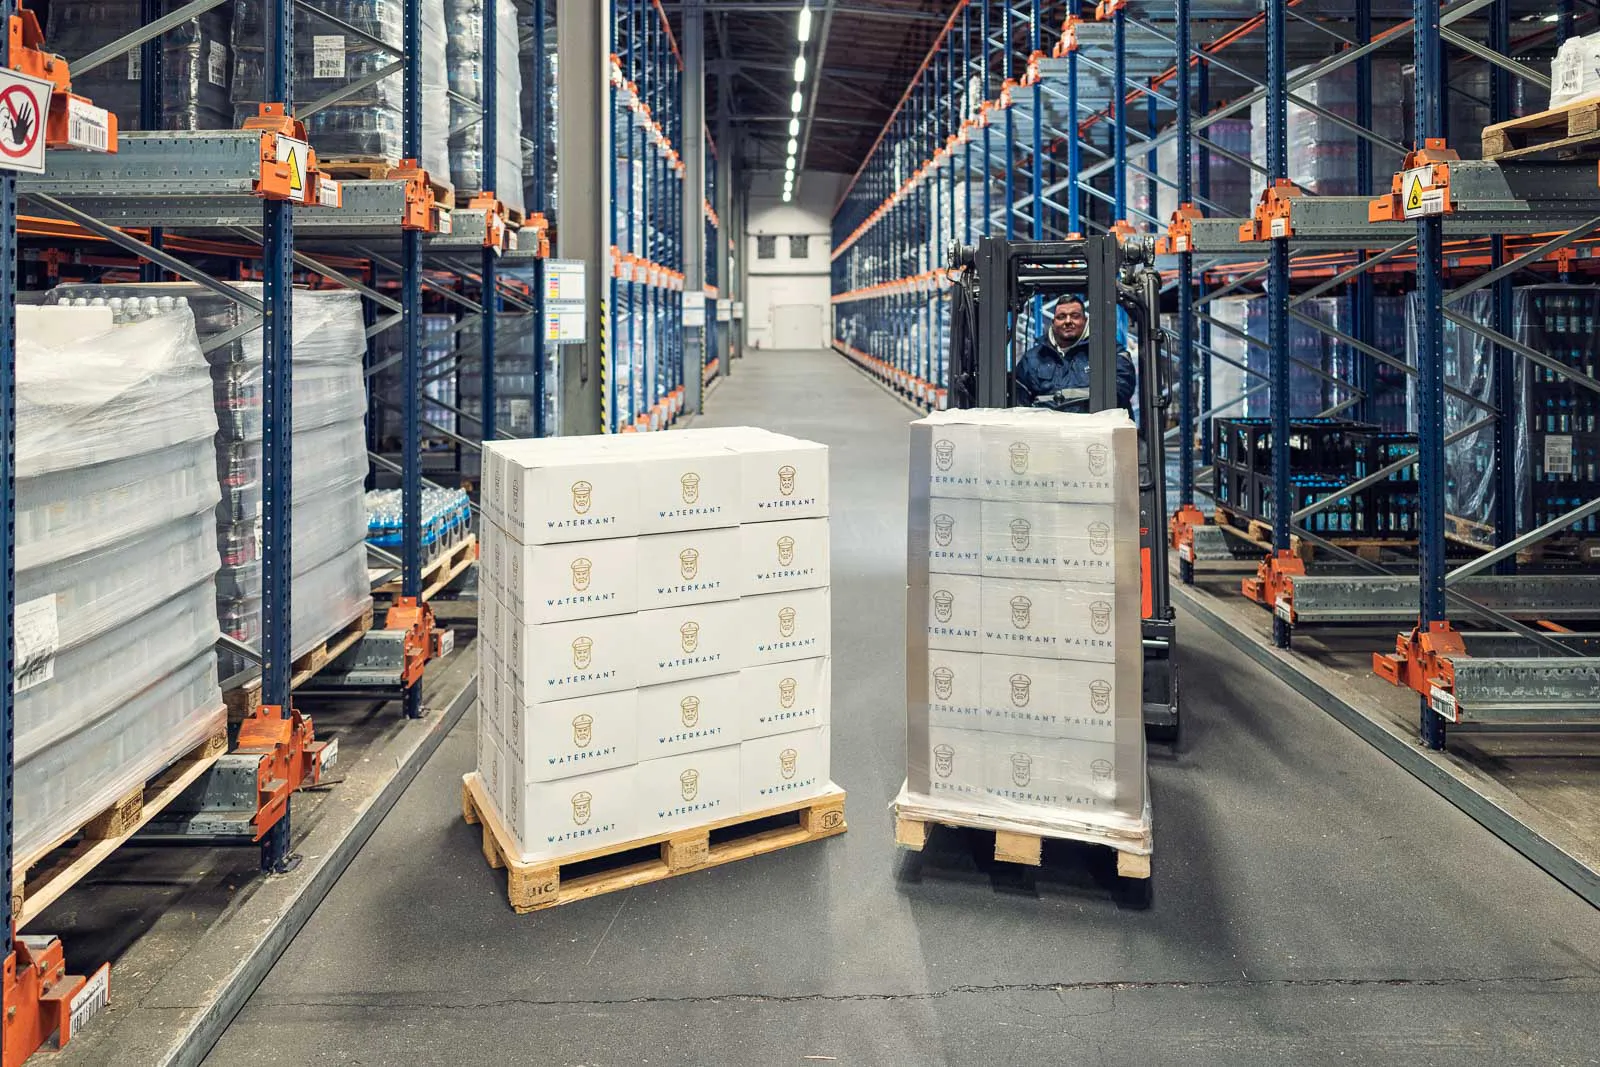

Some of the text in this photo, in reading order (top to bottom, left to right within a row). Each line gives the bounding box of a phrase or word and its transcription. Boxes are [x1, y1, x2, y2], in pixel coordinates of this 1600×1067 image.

[929, 476, 978, 485] TERKANT
[985, 479, 1055, 488] WATERKANT
[1062, 480, 1109, 489] WATERK
[758, 498, 816, 509] WATERKANT
[659, 506, 721, 518] WATERKANT
[548, 516, 616, 528] WATERKANT
[928, 551, 978, 560] TERKANT
[986, 555, 1056, 565] WATERKANT
[1063, 559, 1110, 568] WATERK
[756, 568, 815, 579] WATERKANT
[658, 581, 721, 594] WATERKANT
[547, 592, 616, 606] WATERKANT
[928, 626, 977, 637] TERKANT
[986, 631, 1056, 644] WATERKANT
[758, 637, 816, 652] WATERKANT
[1064, 637, 1112, 648] WATERK
[659, 653, 721, 668] WATERKANT
[548, 670, 616, 685] WATERKANT
[928, 703, 978, 715] TERKANT
[759, 708, 816, 723] WATERKANT
[985, 709, 1056, 723] WATERKANT
[1064, 716, 1112, 727] WATERK
[659, 727, 721, 744] WATERKANT
[549, 747, 616, 765] WATERKANT
[760, 777, 816, 796] WATERKANT
[986, 786, 1057, 803] WATERKANT
[658, 799, 721, 818] WATERKANT
[548, 823, 616, 843] WATERKANT
